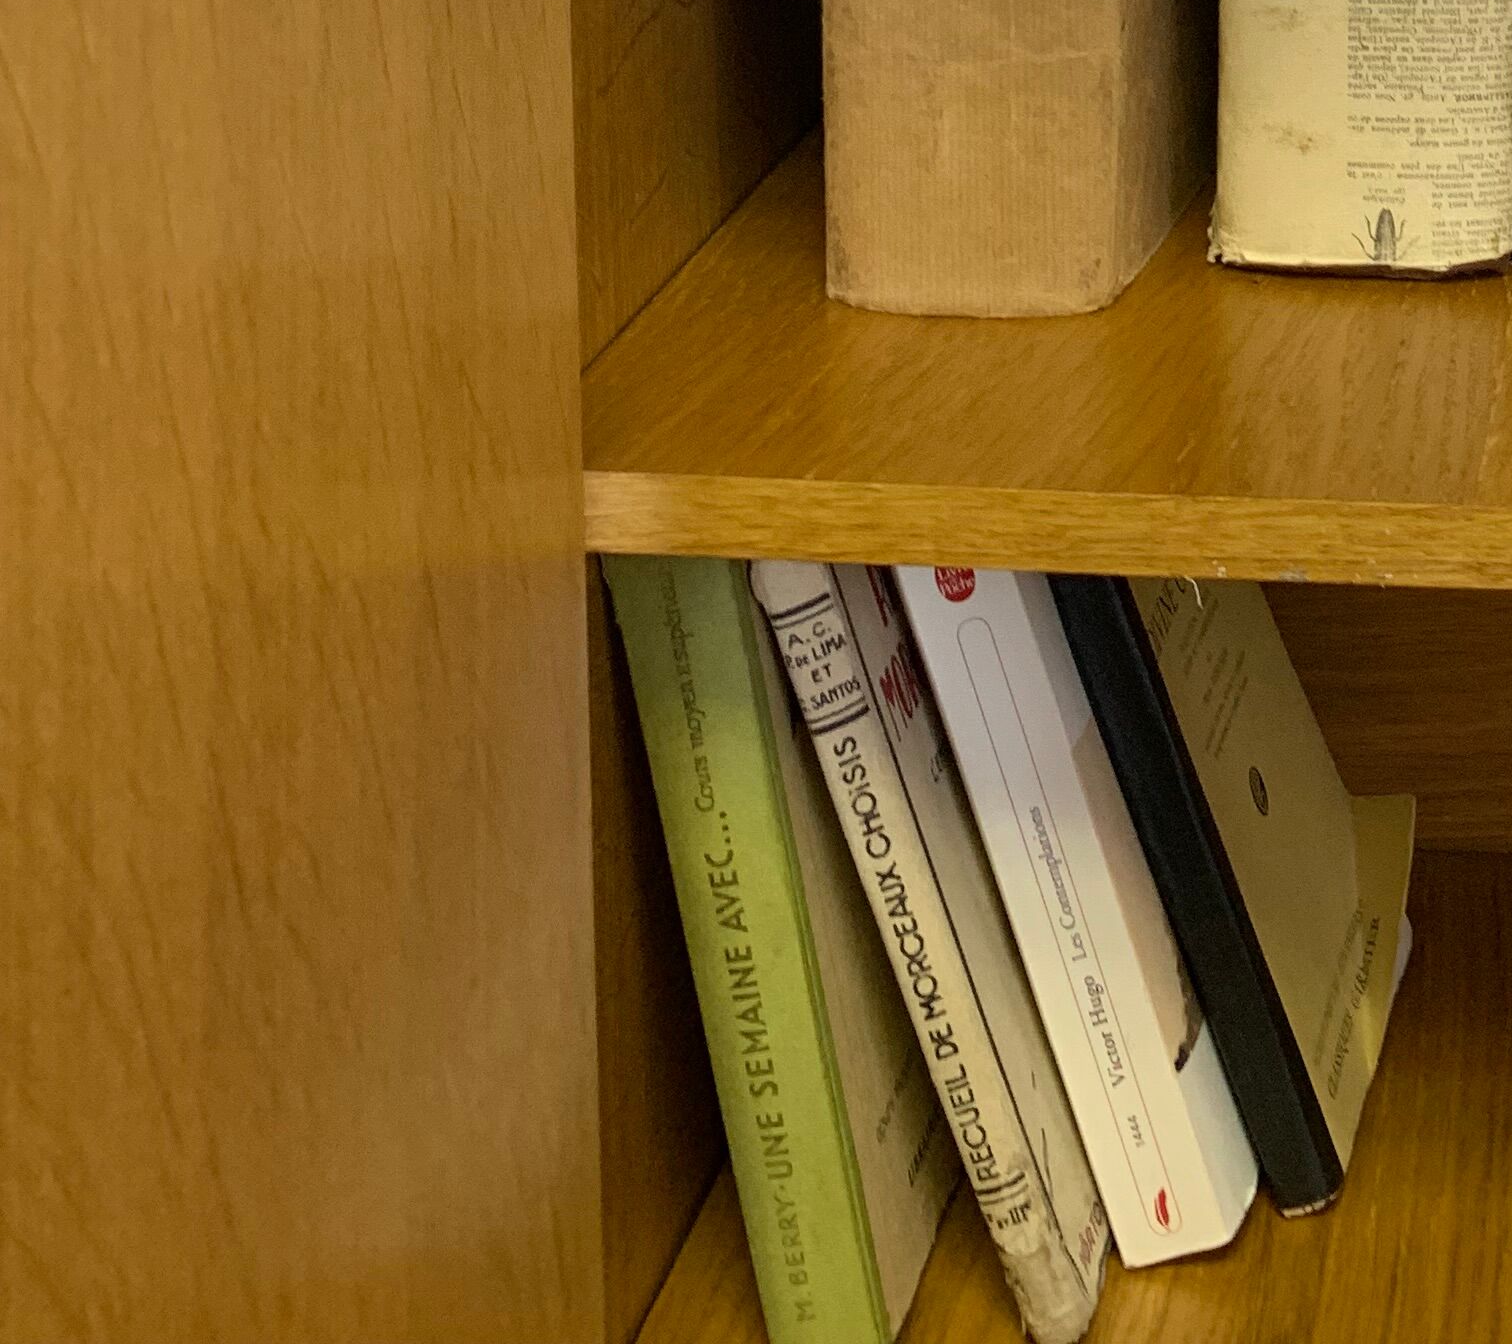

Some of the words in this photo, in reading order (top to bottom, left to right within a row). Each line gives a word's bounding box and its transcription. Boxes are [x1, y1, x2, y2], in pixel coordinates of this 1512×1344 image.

[811, 633, 848, 660] LIMA
[811, 663, 832, 683] ET
[833, 735, 891, 860] CHOISIS
[875, 861, 947, 1021] MORCEAUX
[1072, 932, 1087, 962] Les
[723, 944, 780, 1097] SEMAINE
[1084, 974, 1108, 1027] Hugo
[930, 1023, 960, 1061] DE
[1101, 1031, 1126, 1089] Victor
[945, 1063, 1000, 1183] RECUEIL
